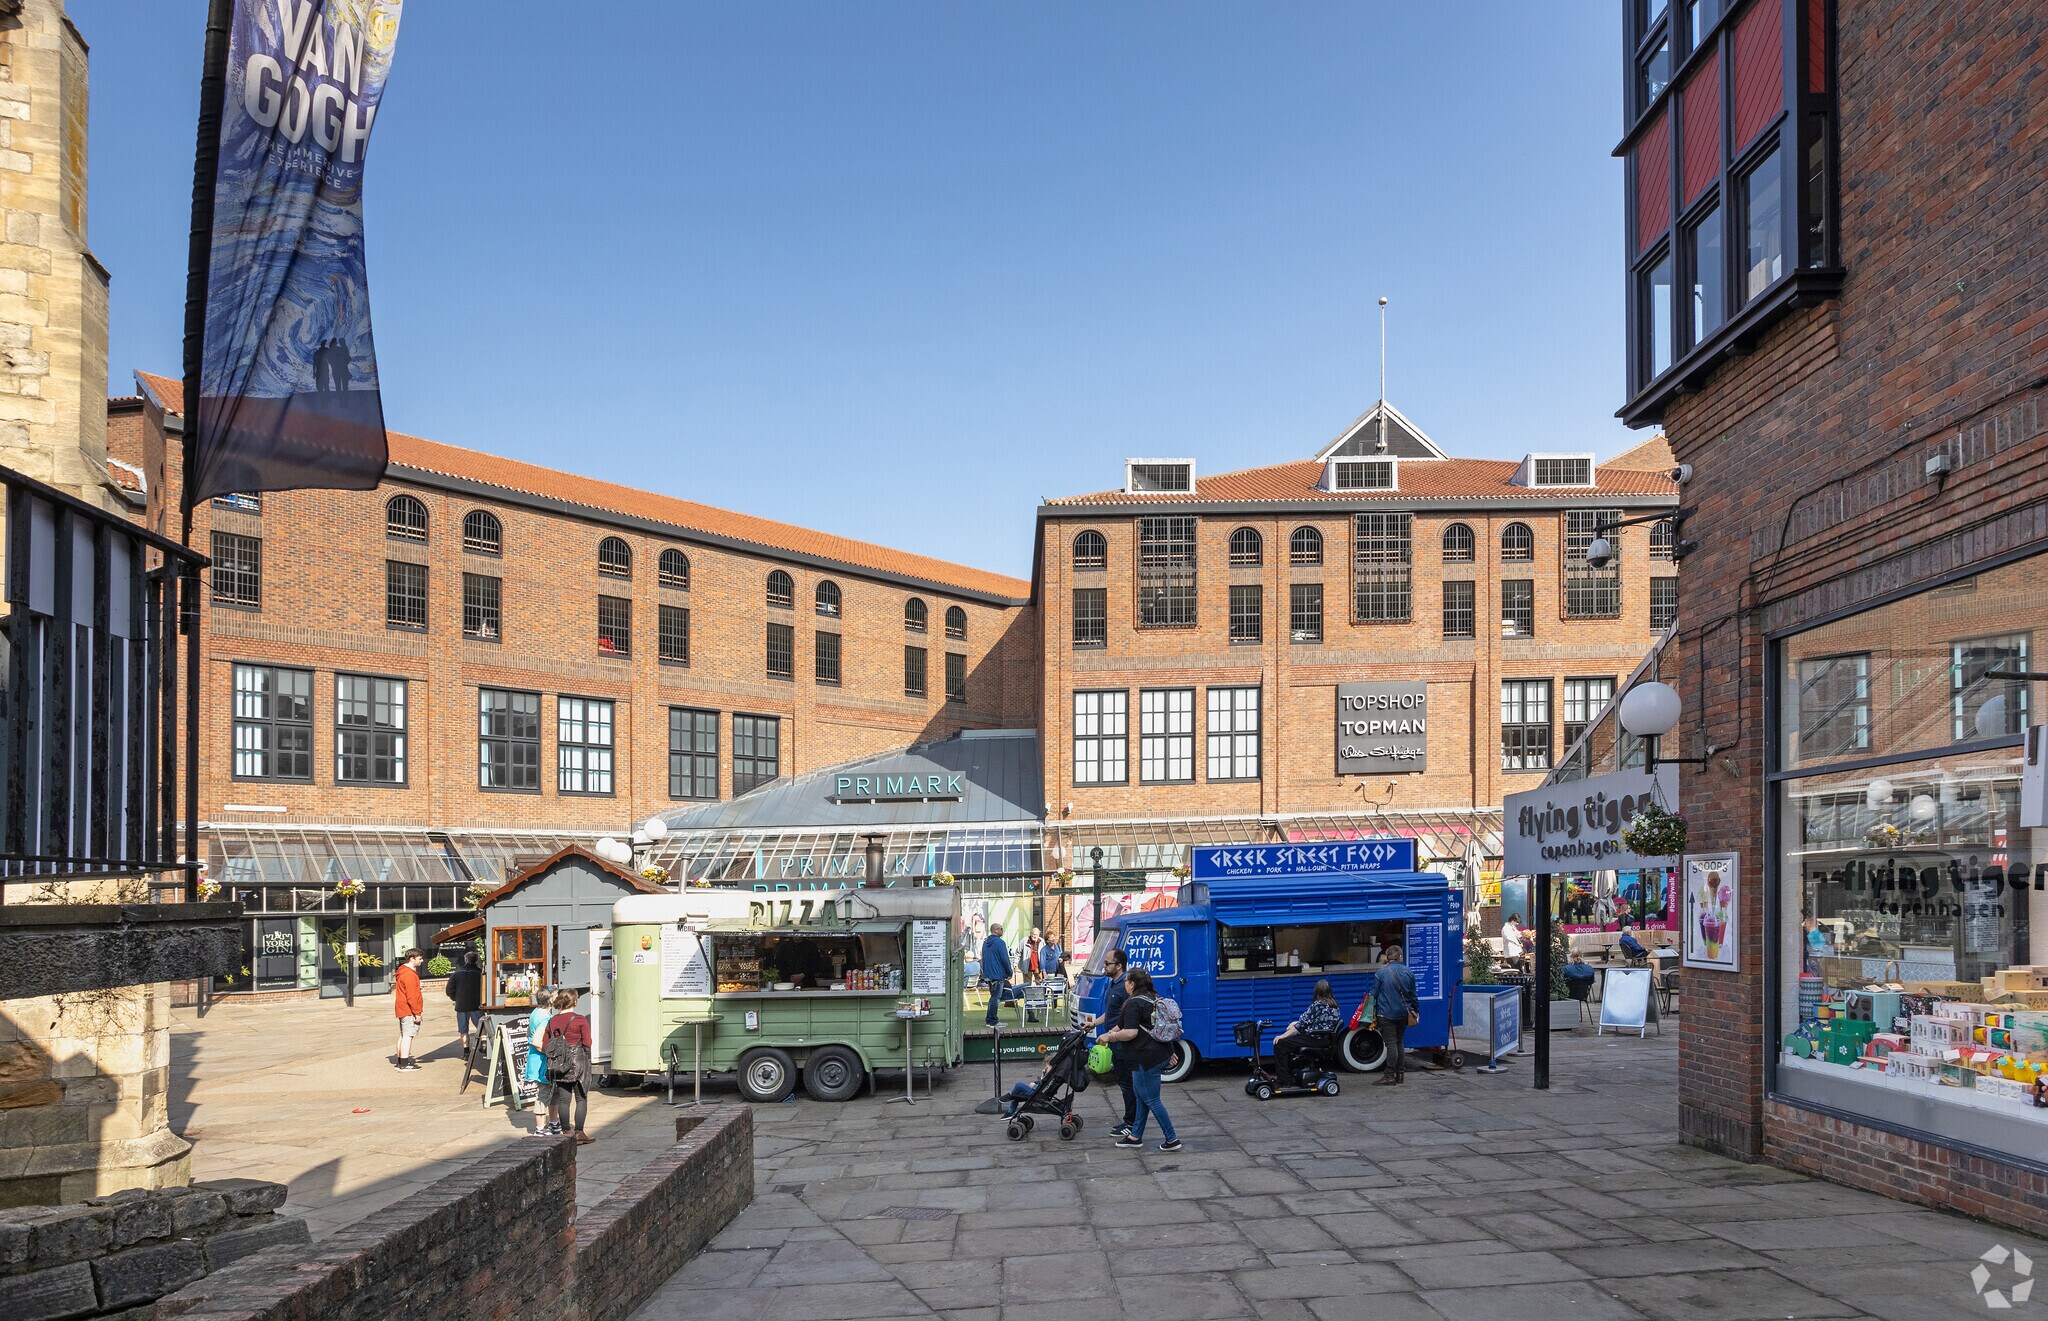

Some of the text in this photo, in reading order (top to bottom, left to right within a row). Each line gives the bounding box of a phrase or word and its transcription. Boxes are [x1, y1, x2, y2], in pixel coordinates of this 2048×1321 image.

[277, 0, 363, 96] VAN
[244, 53, 377, 163] GOGH
[264, 135, 353, 178] THE IMMERSIVE
[268, 153, 341, 188] EXPERIENCE
[1341, 693, 1425, 711] TOPSHOP
[1341, 718, 1425, 735] TOPMAN
[837, 775, 963, 796] PRIMARK
[1518, 791, 1652, 842] flying tiger
[1210, 843, 1397, 868] GREEK STREET FOOD
[1541, 839, 1620, 861] copenhagen
[780, 854, 910, 875] PRIMAK
[1226, 867, 1253, 875] CHICKEN
[1341, 863, 1359, 871] PITTA
[1359, 862, 1381, 870] WRAPS
[1692, 861, 1729, 874] SCOOPS
[1843, 855, 2048, 898] flying tiger
[749, 899, 853, 928] PIZZA!
[1878, 901, 2005, 921] copenhagen
[677, 924, 696, 932] Menu
[1127, 934, 1164, 946] GYROS
[1129, 947, 1162, 959] PITTA
[1016, 1045, 1035, 1054] sitting
[1037, 1043, 1060, 1054] Comf
